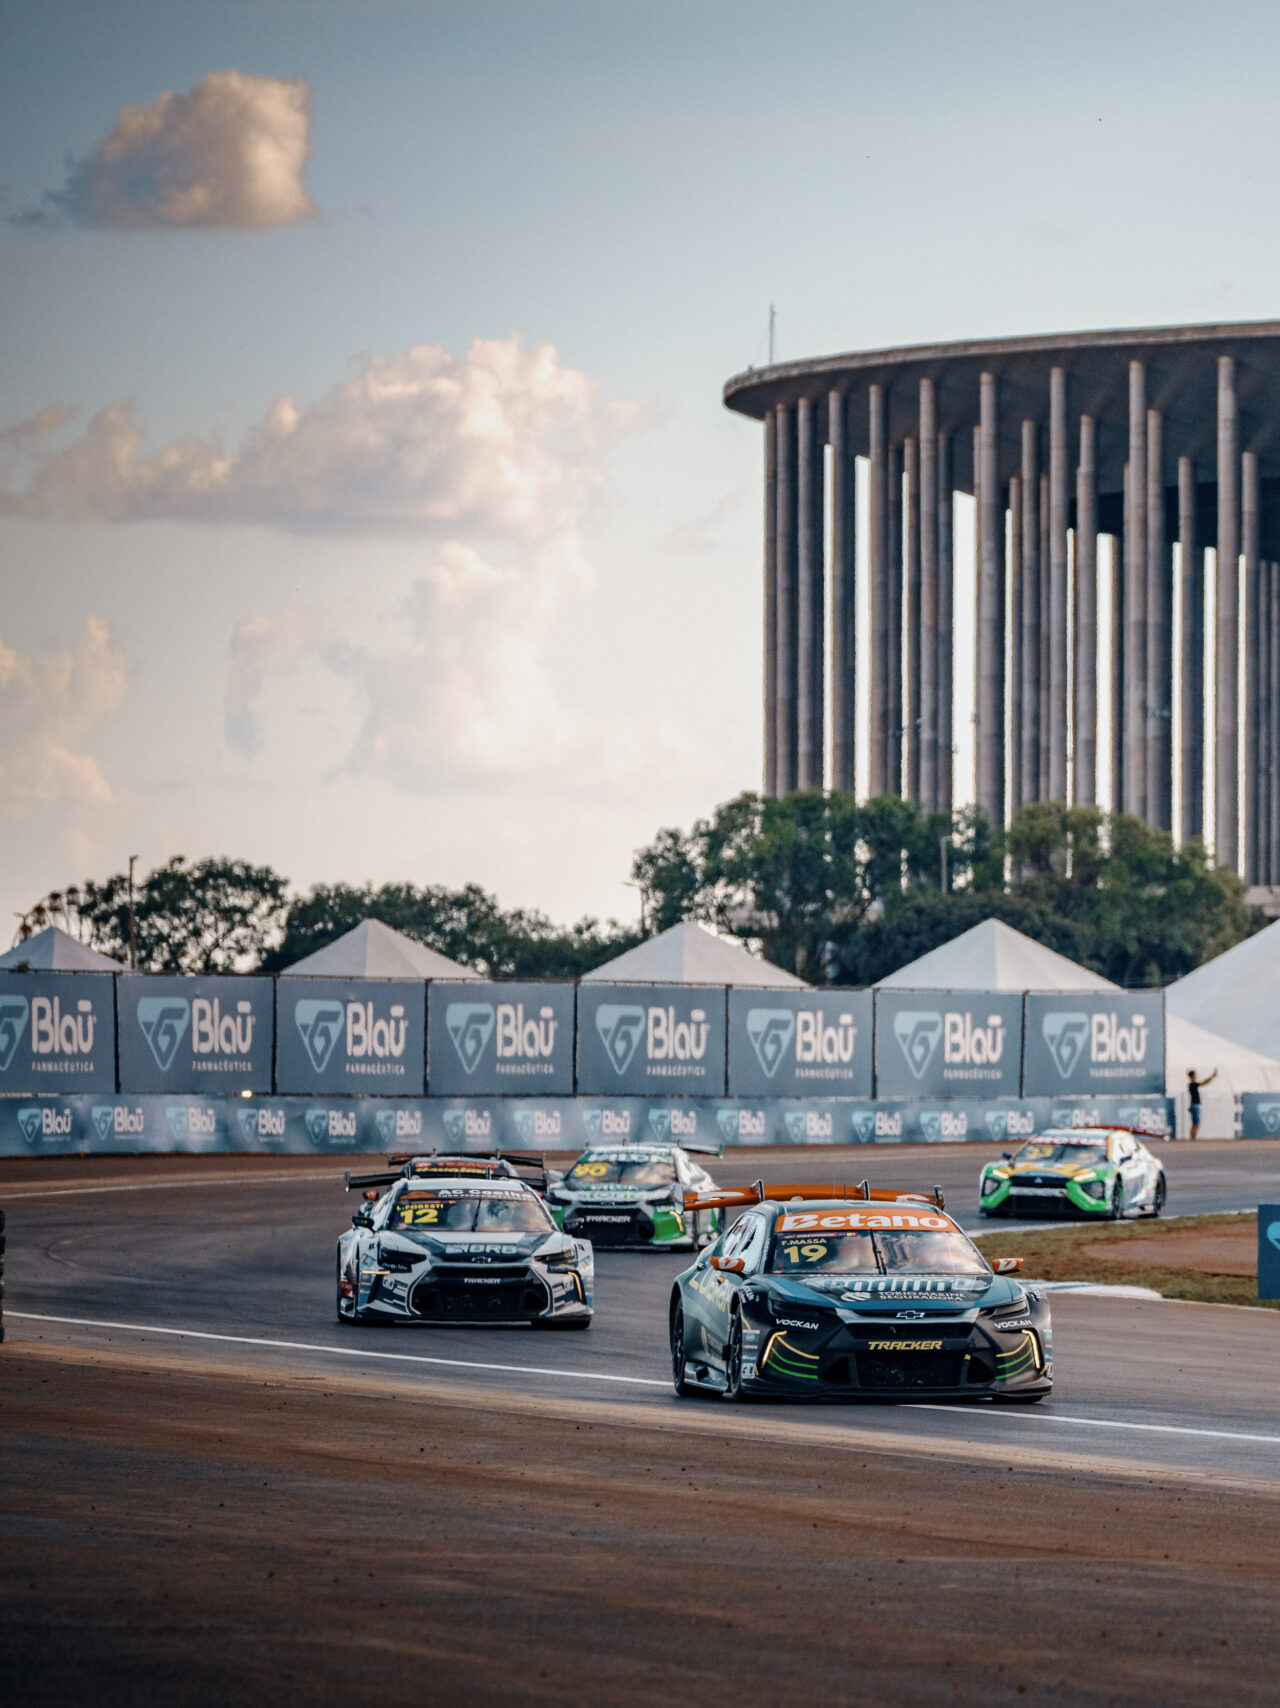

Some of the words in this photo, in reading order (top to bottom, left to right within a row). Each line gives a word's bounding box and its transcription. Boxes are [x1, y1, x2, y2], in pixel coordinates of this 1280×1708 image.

[400, 1209, 438, 1224] 12
[782, 1213, 949, 1231] Betano
[783, 1245, 828, 1263] 19
[775, 1318, 819, 1330] VOCKAN
[994, 1319, 1033, 1329] VOCKAN
[868, 1340, 943, 1350] TRACKER
